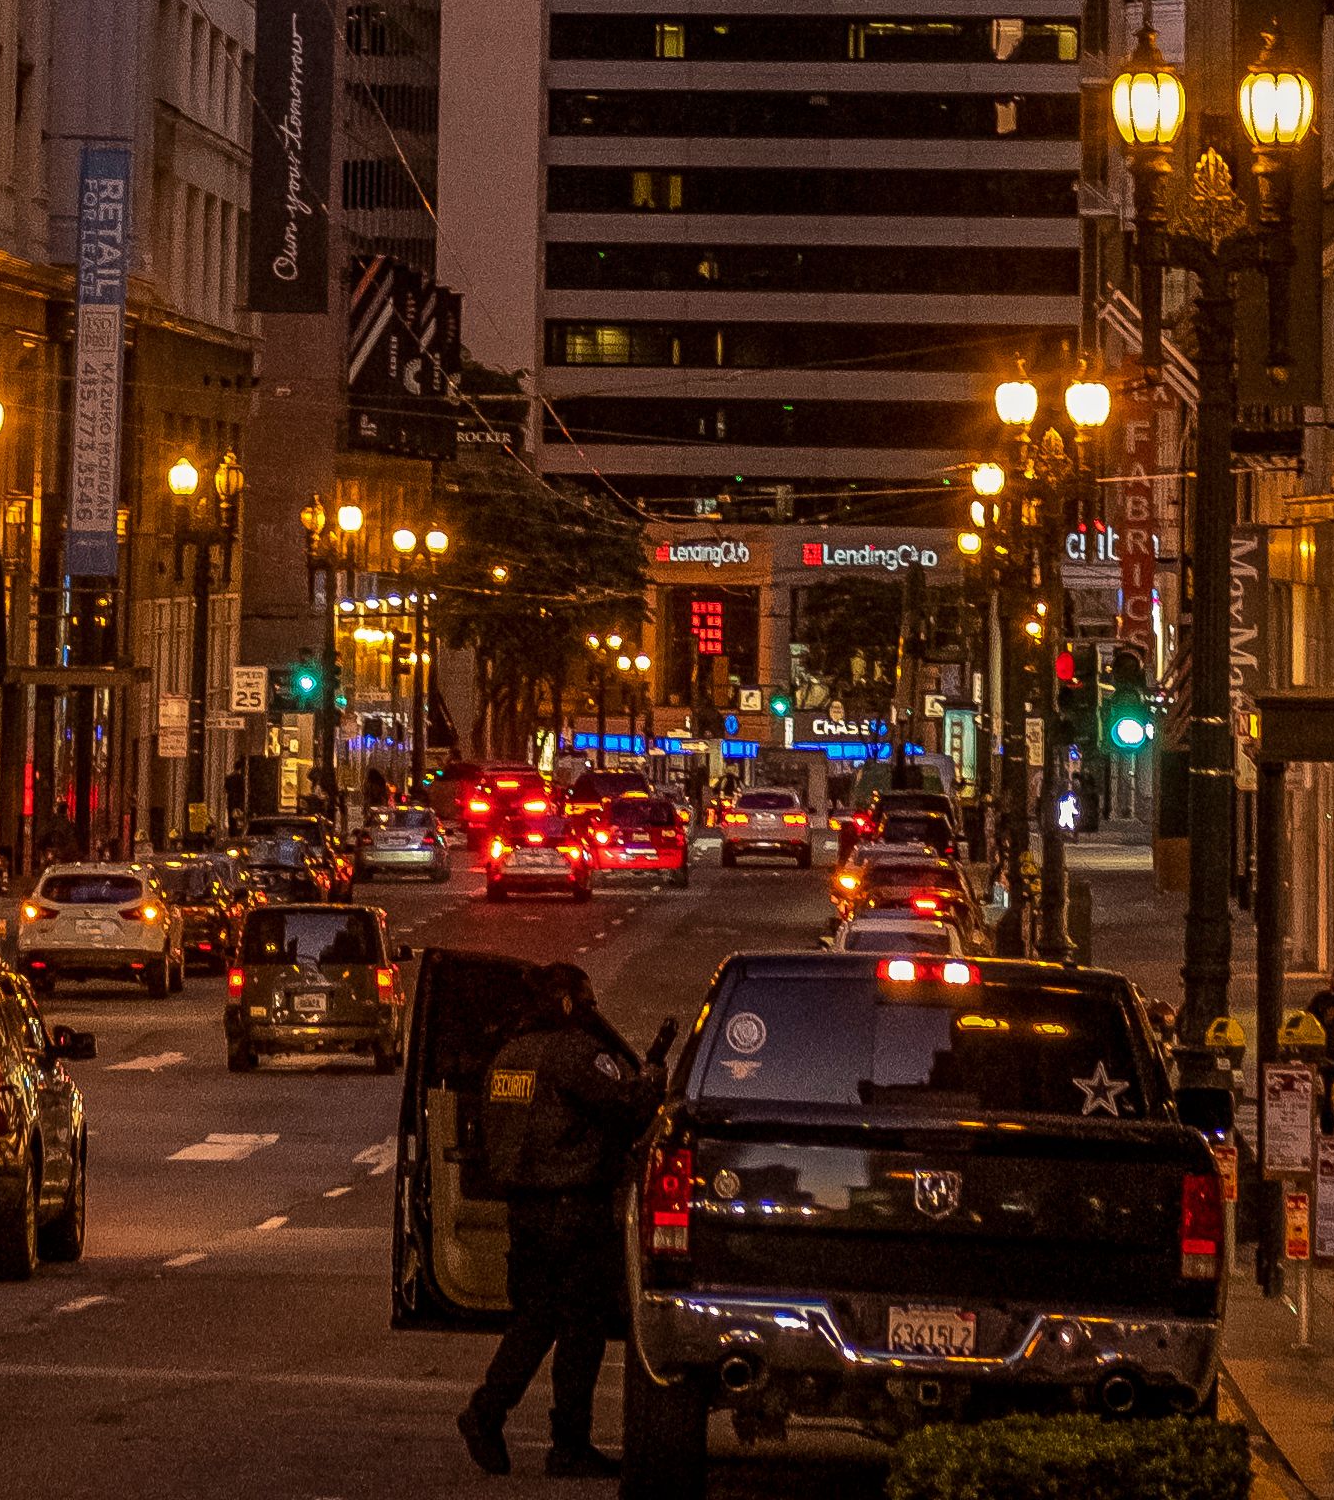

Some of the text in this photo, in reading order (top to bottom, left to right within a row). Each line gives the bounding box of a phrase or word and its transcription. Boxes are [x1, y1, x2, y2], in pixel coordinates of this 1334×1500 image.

[272, 12, 312, 281] Own your tomorrow
[80, 178, 99, 299] FOR LEASE
[96, 178, 125, 297] RETAIL
[235, 691, 263, 708] 25
[492, 1073, 533, 1098] SECURITY
